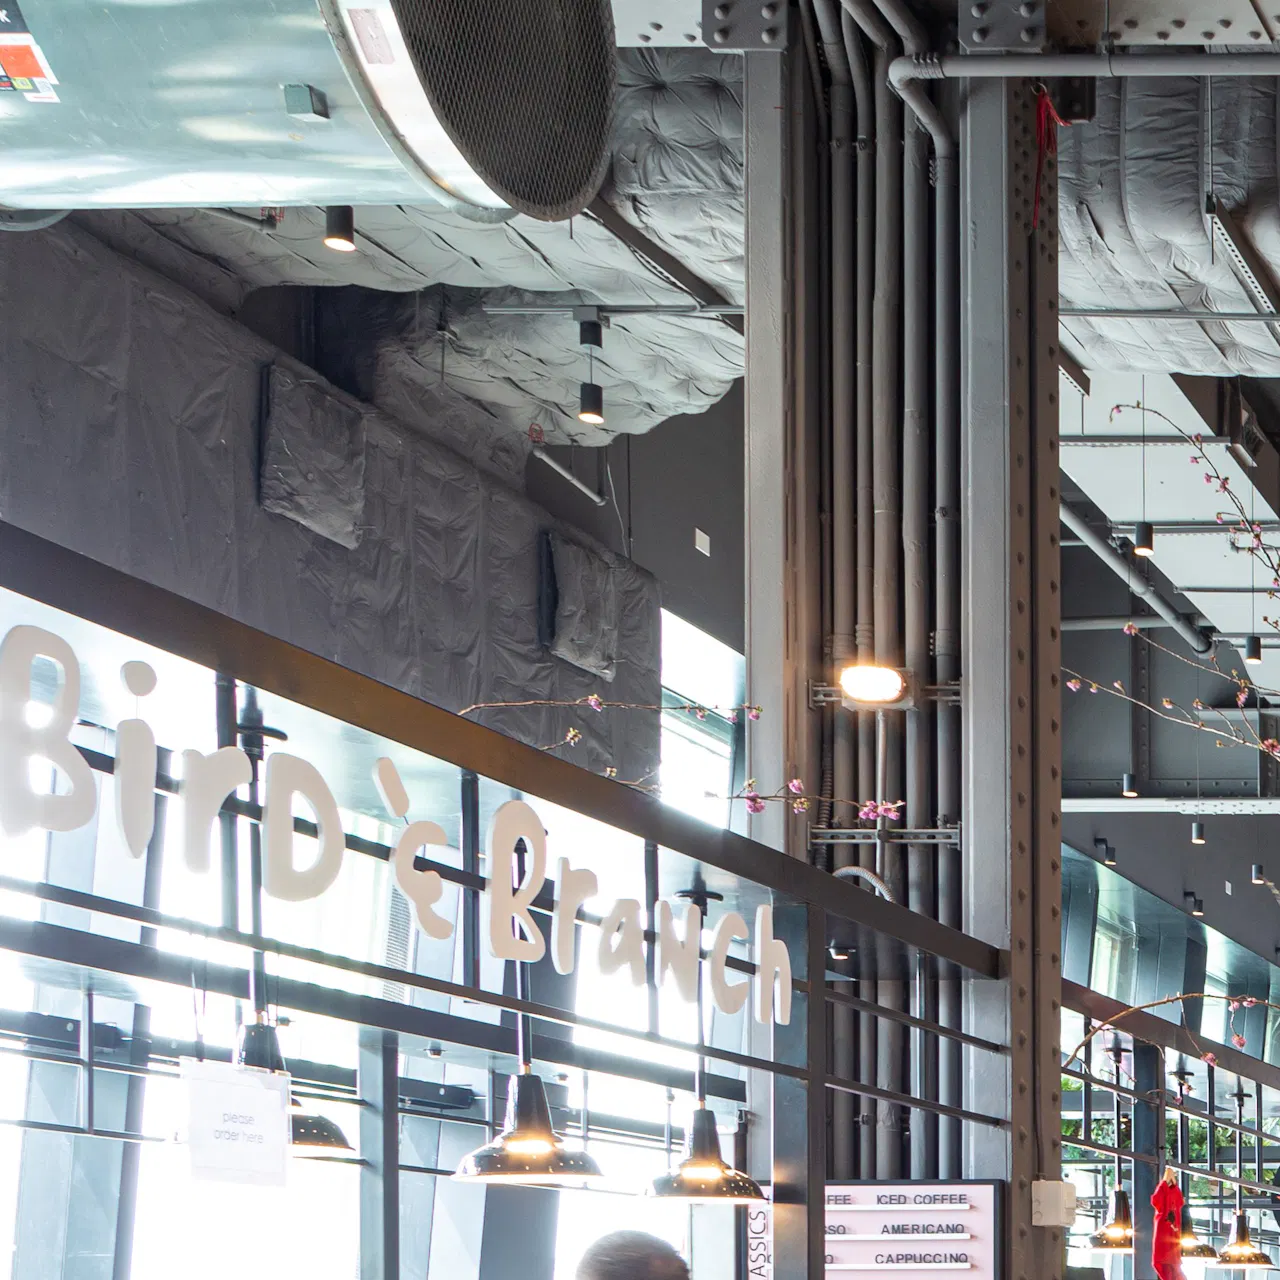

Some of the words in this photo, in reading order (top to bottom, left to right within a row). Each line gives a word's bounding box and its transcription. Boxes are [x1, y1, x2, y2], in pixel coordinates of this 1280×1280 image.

[223, 1112, 255, 1124] please
[214, 1129, 240, 1141] order
[242, 1130, 264, 1144] here
[876, 1193, 907, 1206] ICED
[913, 1193, 968, 1206] COFFEE
[880, 1223, 965, 1235] AMERICANO
[874, 1253, 969, 1264] CAPPUCCINO
